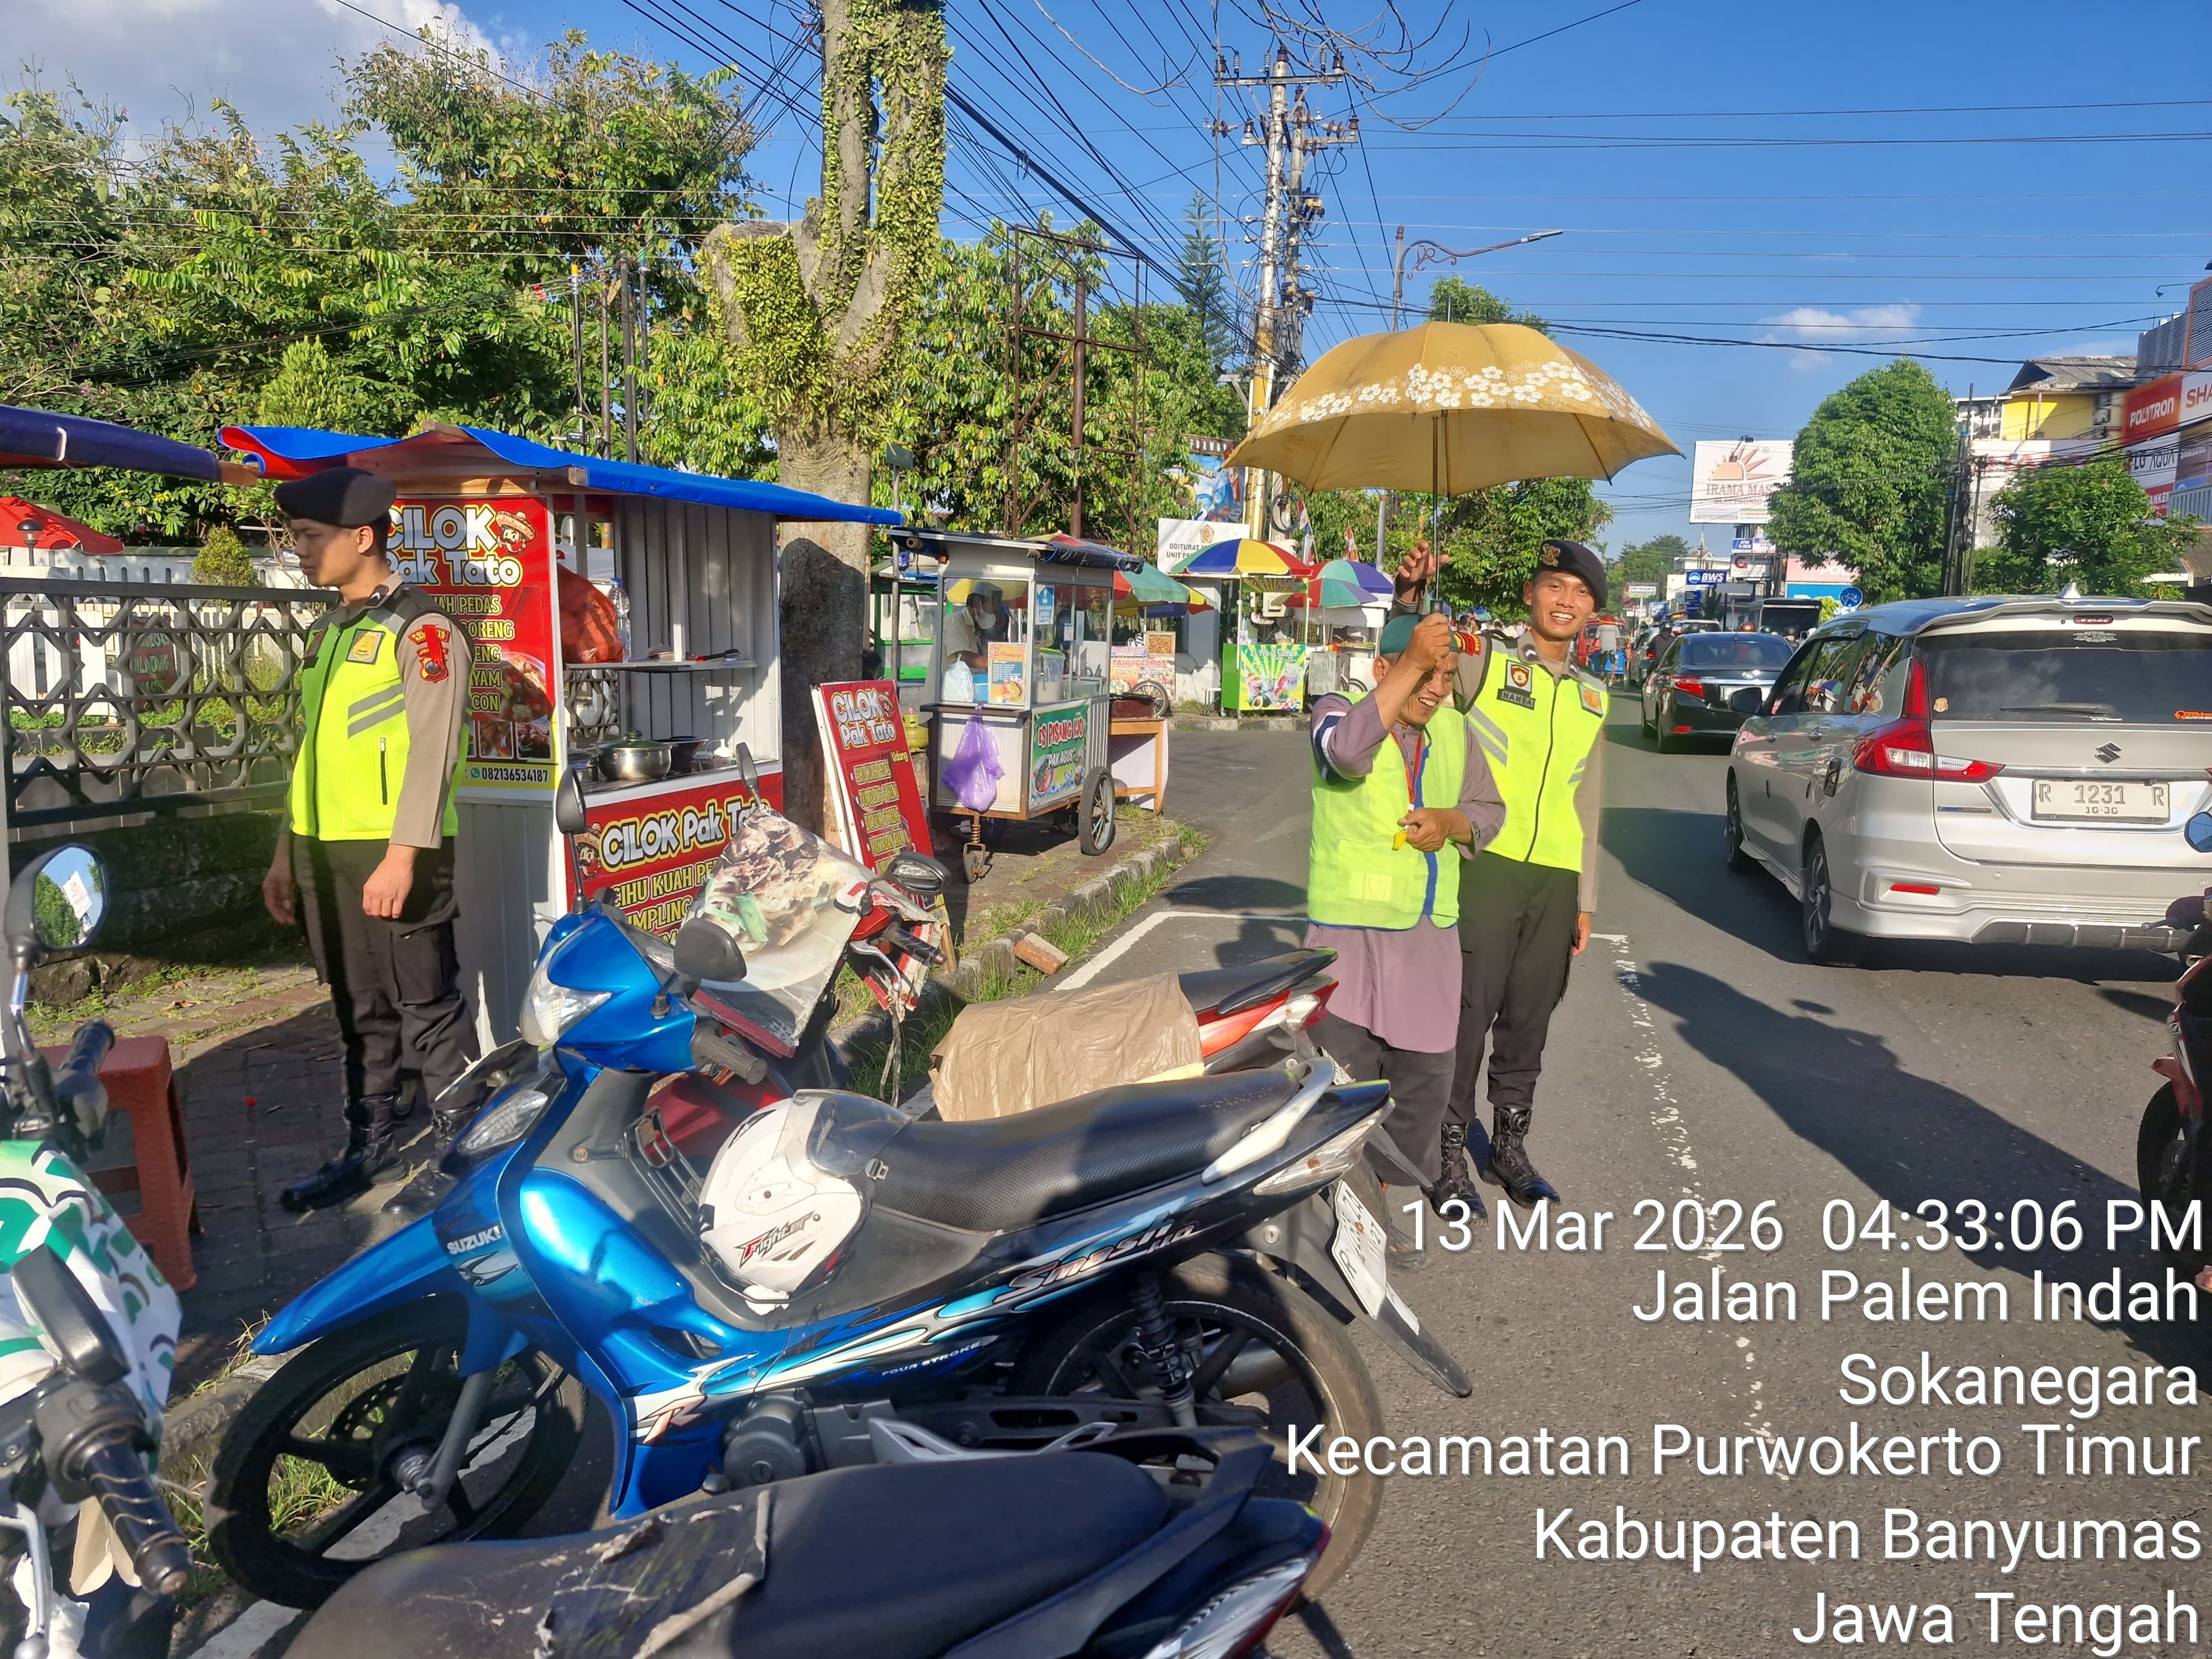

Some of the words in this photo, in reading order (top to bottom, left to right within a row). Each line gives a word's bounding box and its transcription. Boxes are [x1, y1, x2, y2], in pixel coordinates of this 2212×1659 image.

[2130, 397, 2174, 427] POLYTRON
[2133, 452, 2146, 470] LG
[1706, 484, 1744, 495] IRAMA
[387, 507, 497, 550] CILOK
[388, 549, 439, 584] Pak
[446, 550, 520, 585] Tato
[459, 596, 501, 614] PEDAS
[473, 695, 499, 710] CON
[832, 691, 883, 723] CILOK
[840, 721, 868, 748] Pak
[867, 719, 895, 742] Tato
[1039, 724, 1046, 747] ES
[1048, 721, 1072, 746] PISANG
[1074, 717, 1083, 738] IJO
[891, 750, 908, 763] Udang
[482, 768, 548, 782] 082136534187
[2039, 784, 2052, 802] R
[2074, 785, 2126, 805] 1231
[2152, 787, 2164, 806] R
[603, 812, 680, 865] CILOK
[683, 804, 723, 848] Pak
[653, 868, 693, 897] KUAH
[447, 1225, 502, 1254] SUZUKI
[735, 1211, 815, 1268] Fighter
[993, 1211, 1175, 1304] Smash
[881, 1363, 918, 1376] FOUR
[922, 1341, 980, 1366] STROKE
